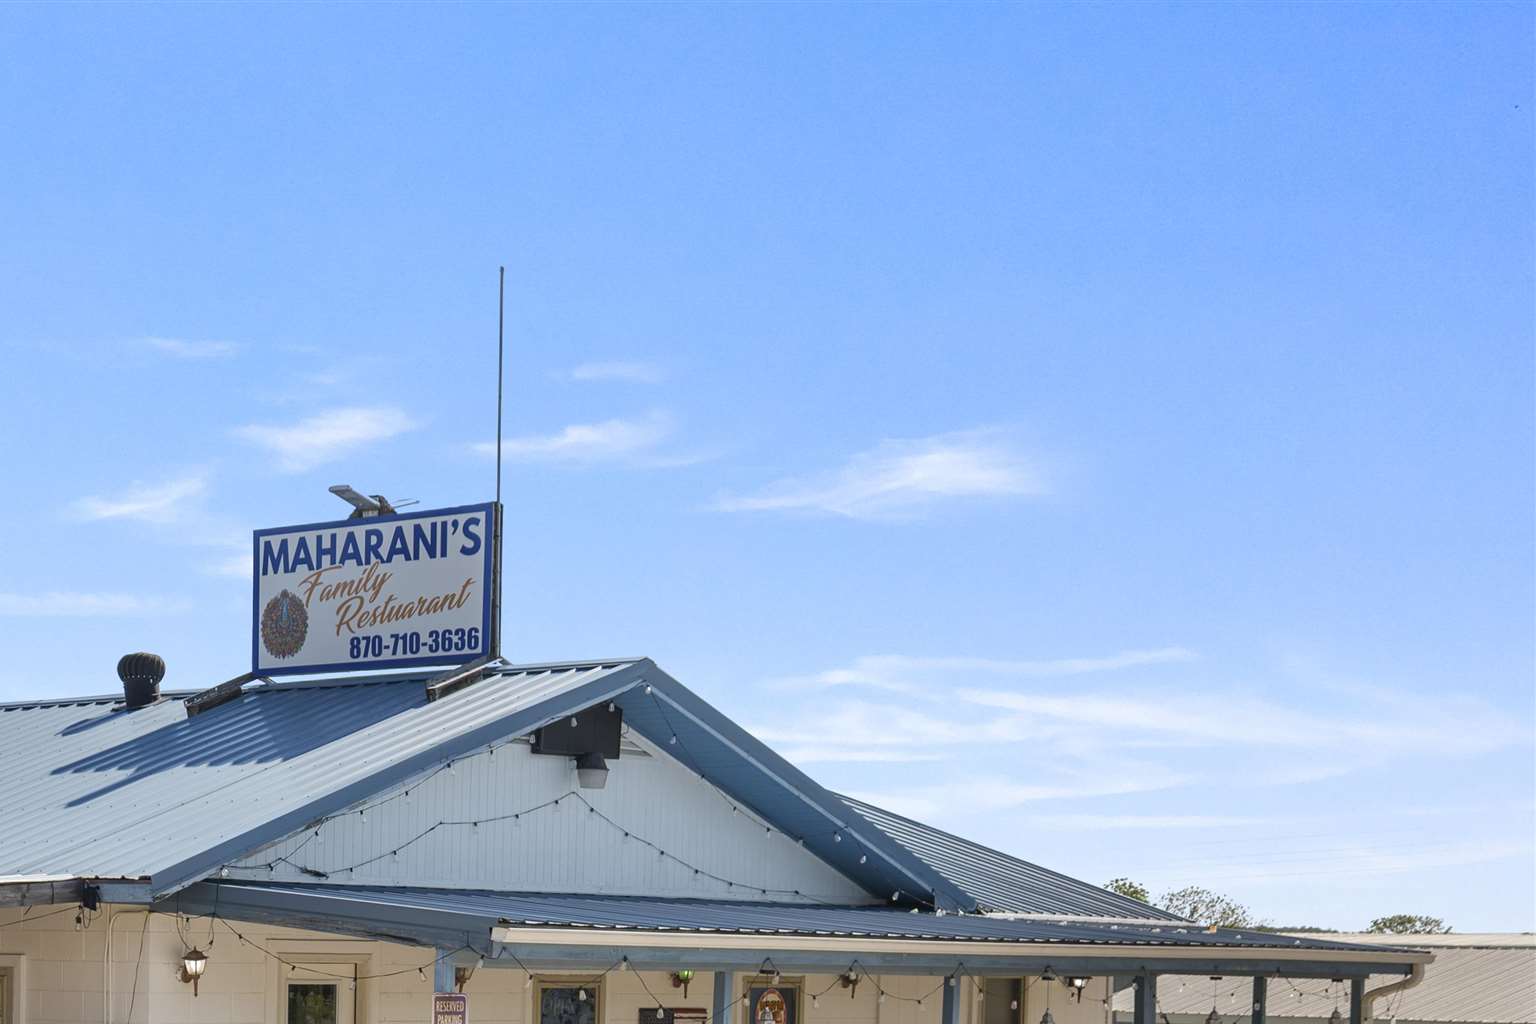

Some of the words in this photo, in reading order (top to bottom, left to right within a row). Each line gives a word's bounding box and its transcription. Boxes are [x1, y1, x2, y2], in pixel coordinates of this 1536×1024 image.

[262, 516, 482, 576] MAHARANI'S
[298, 561, 393, 608] Family
[336, 577, 476, 636] Restuarant
[349, 627, 480, 659] 870-710-3636
[436, 1000, 465, 1012] RESERVED
[437, 1014, 463, 1024] PARKING
